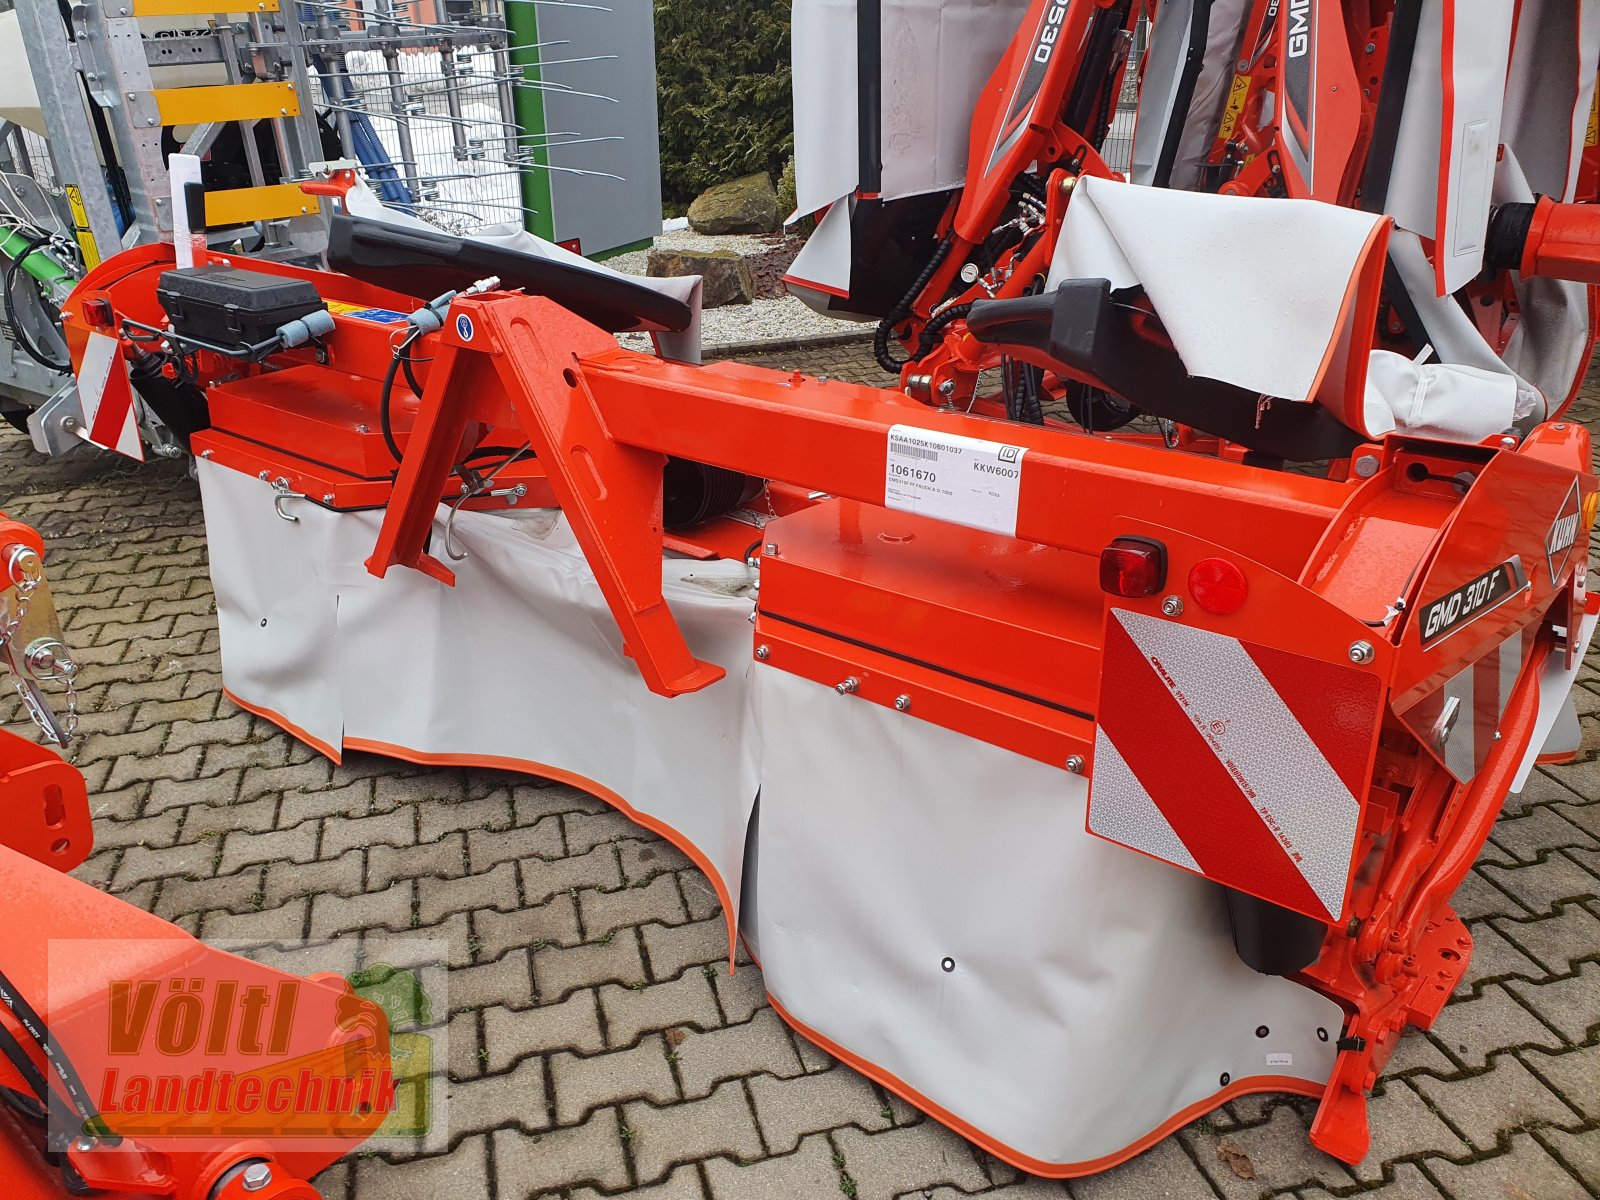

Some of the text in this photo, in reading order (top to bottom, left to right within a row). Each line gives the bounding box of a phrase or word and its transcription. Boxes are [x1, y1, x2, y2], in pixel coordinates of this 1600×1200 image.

[890, 463, 936, 483] 1061670
[973, 462, 1019, 479] KKW6007
[1550, 513, 1580, 555] KUHN
[1425, 569, 1500, 638] GMD 310 F
[1151, 656, 1176, 689] ORALITE
